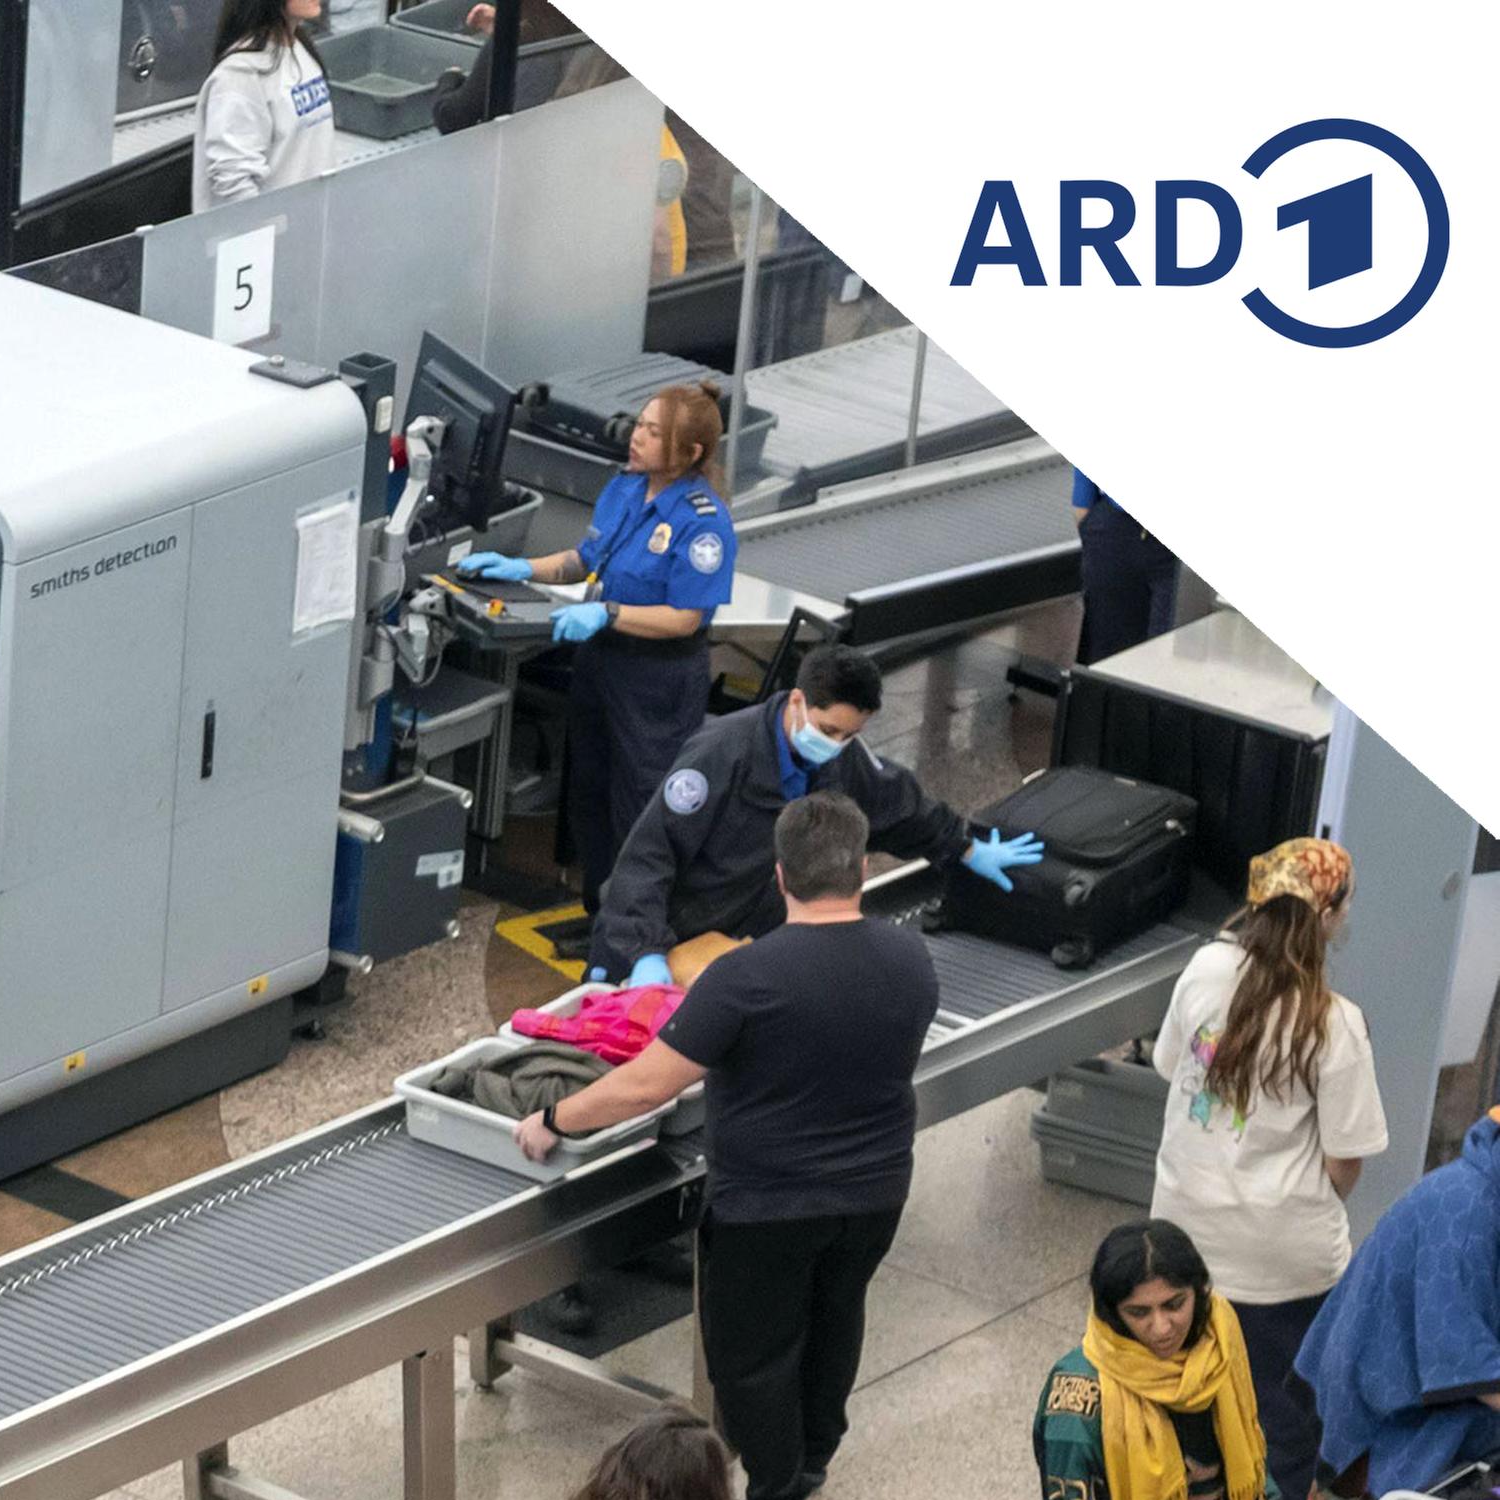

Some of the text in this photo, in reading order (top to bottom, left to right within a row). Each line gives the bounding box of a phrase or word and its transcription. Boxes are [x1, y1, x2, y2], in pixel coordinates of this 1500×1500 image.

[234, 264, 253, 311] 5
[30, 535, 178, 599] smiths detection
